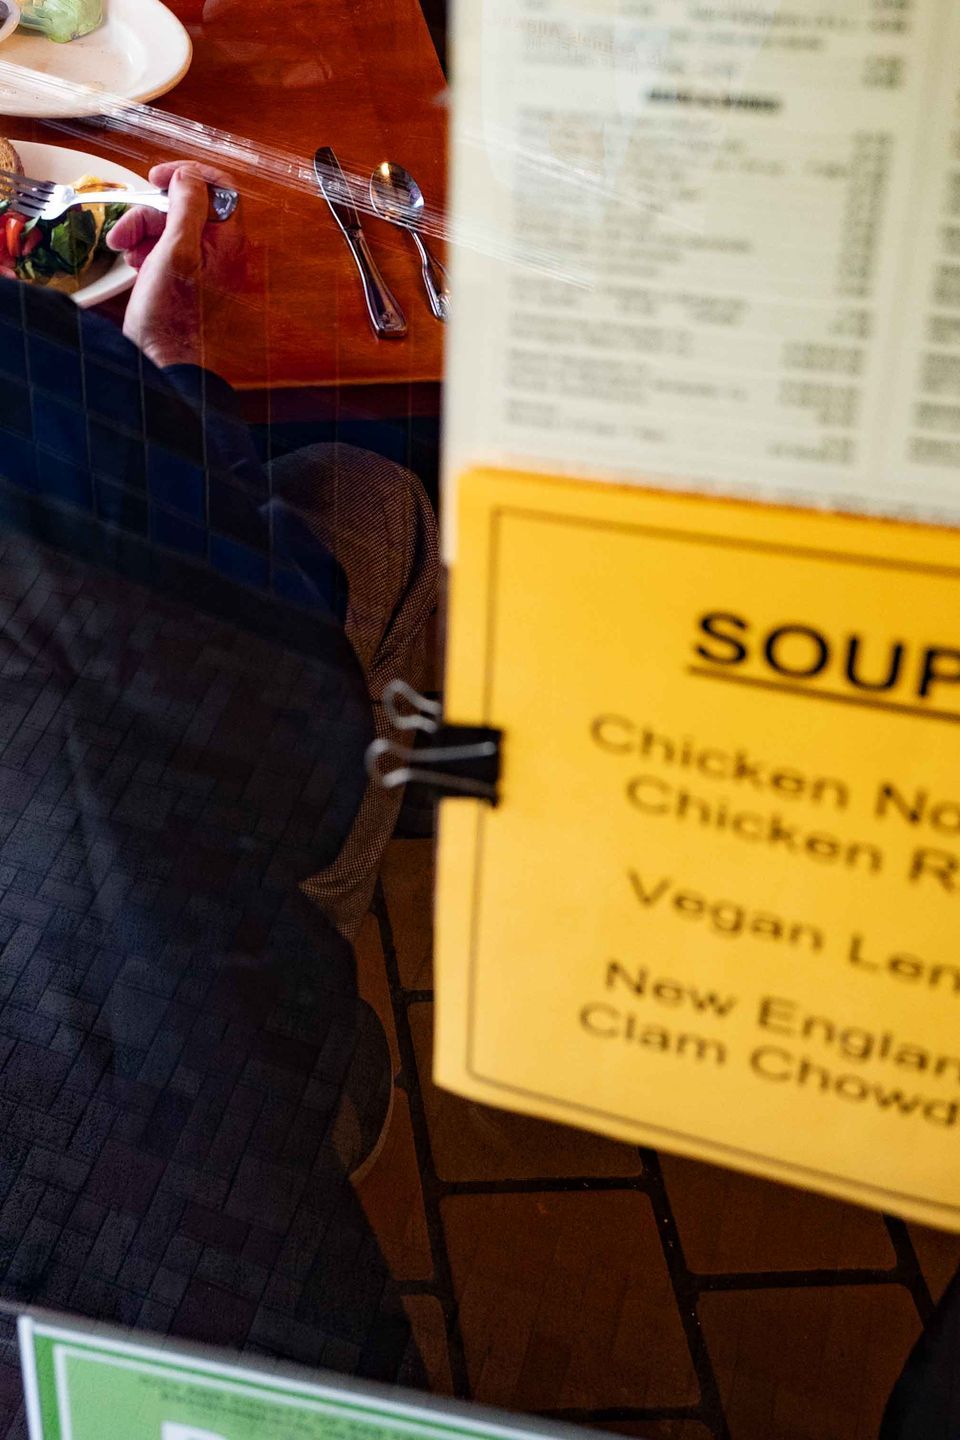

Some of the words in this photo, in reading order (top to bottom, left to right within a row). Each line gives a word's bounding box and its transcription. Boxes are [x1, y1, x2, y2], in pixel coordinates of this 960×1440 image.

[695, 610, 960, 700] SOUP
[590, 712, 849, 811] Chicken
[625, 773, 883, 875] Chicken
[627, 867, 825, 954] Vegan
[605, 957, 736, 1017] New
[579, 1000, 728, 1065] Clam
